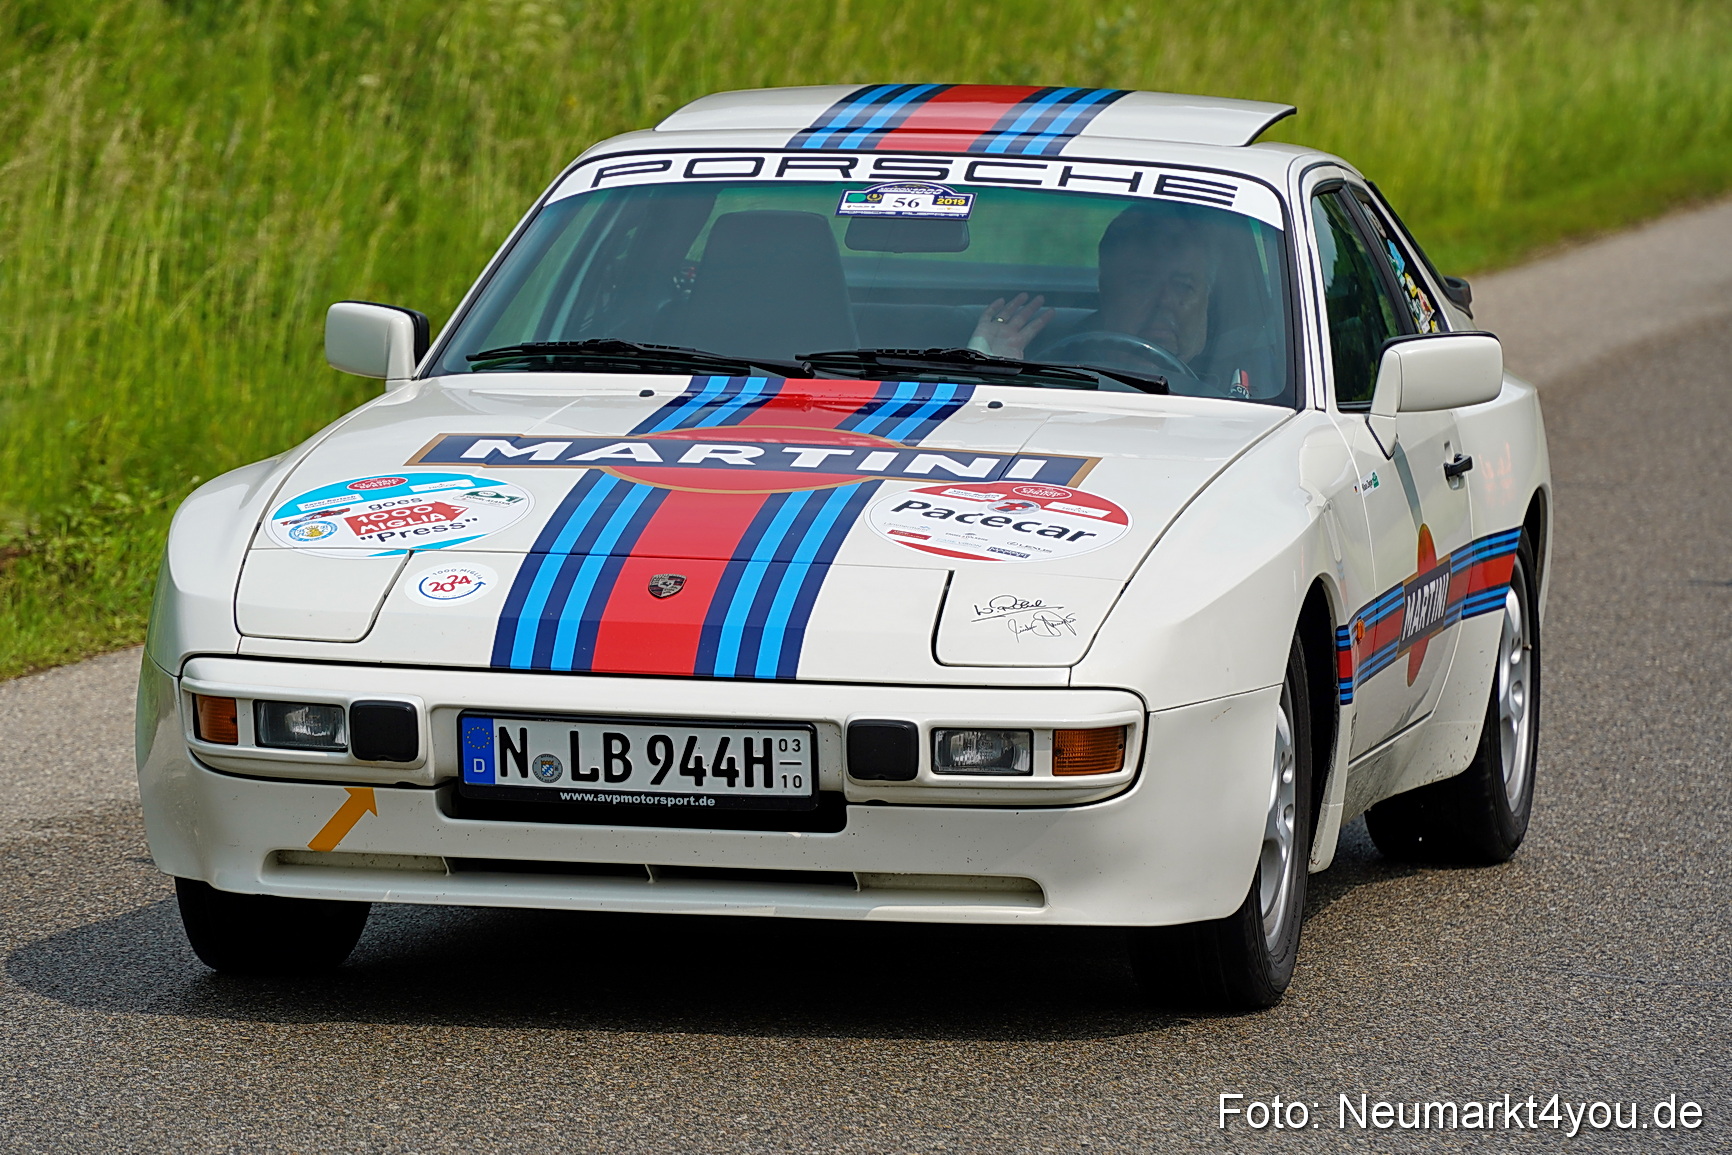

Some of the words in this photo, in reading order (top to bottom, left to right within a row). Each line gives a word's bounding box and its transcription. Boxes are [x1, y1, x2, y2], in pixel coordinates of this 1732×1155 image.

[592, 155, 1238, 207] PORSCHE
[892, 197, 921, 209] 56
[935, 198, 966, 206] 2019
[459, 438, 1047, 480] MARTINI
[368, 496, 423, 511] goes
[355, 504, 433, 523] 1000
[359, 513, 446, 535] MIGLIA
[359, 517, 479, 543] "Press"
[432, 568, 457, 576] 1000
[459, 568, 484, 580] MIGLIA
[1401, 572, 1450, 642] MARTINI
[778, 738, 802, 753] 03
[472, 757, 486, 773] D
[499, 726, 529, 779] N
[570, 730, 632, 784] LB
[647, 733, 774, 789] 944H
[781, 773, 803, 789] 10
[559, 790, 716, 807] www.avpmotorsport.de
